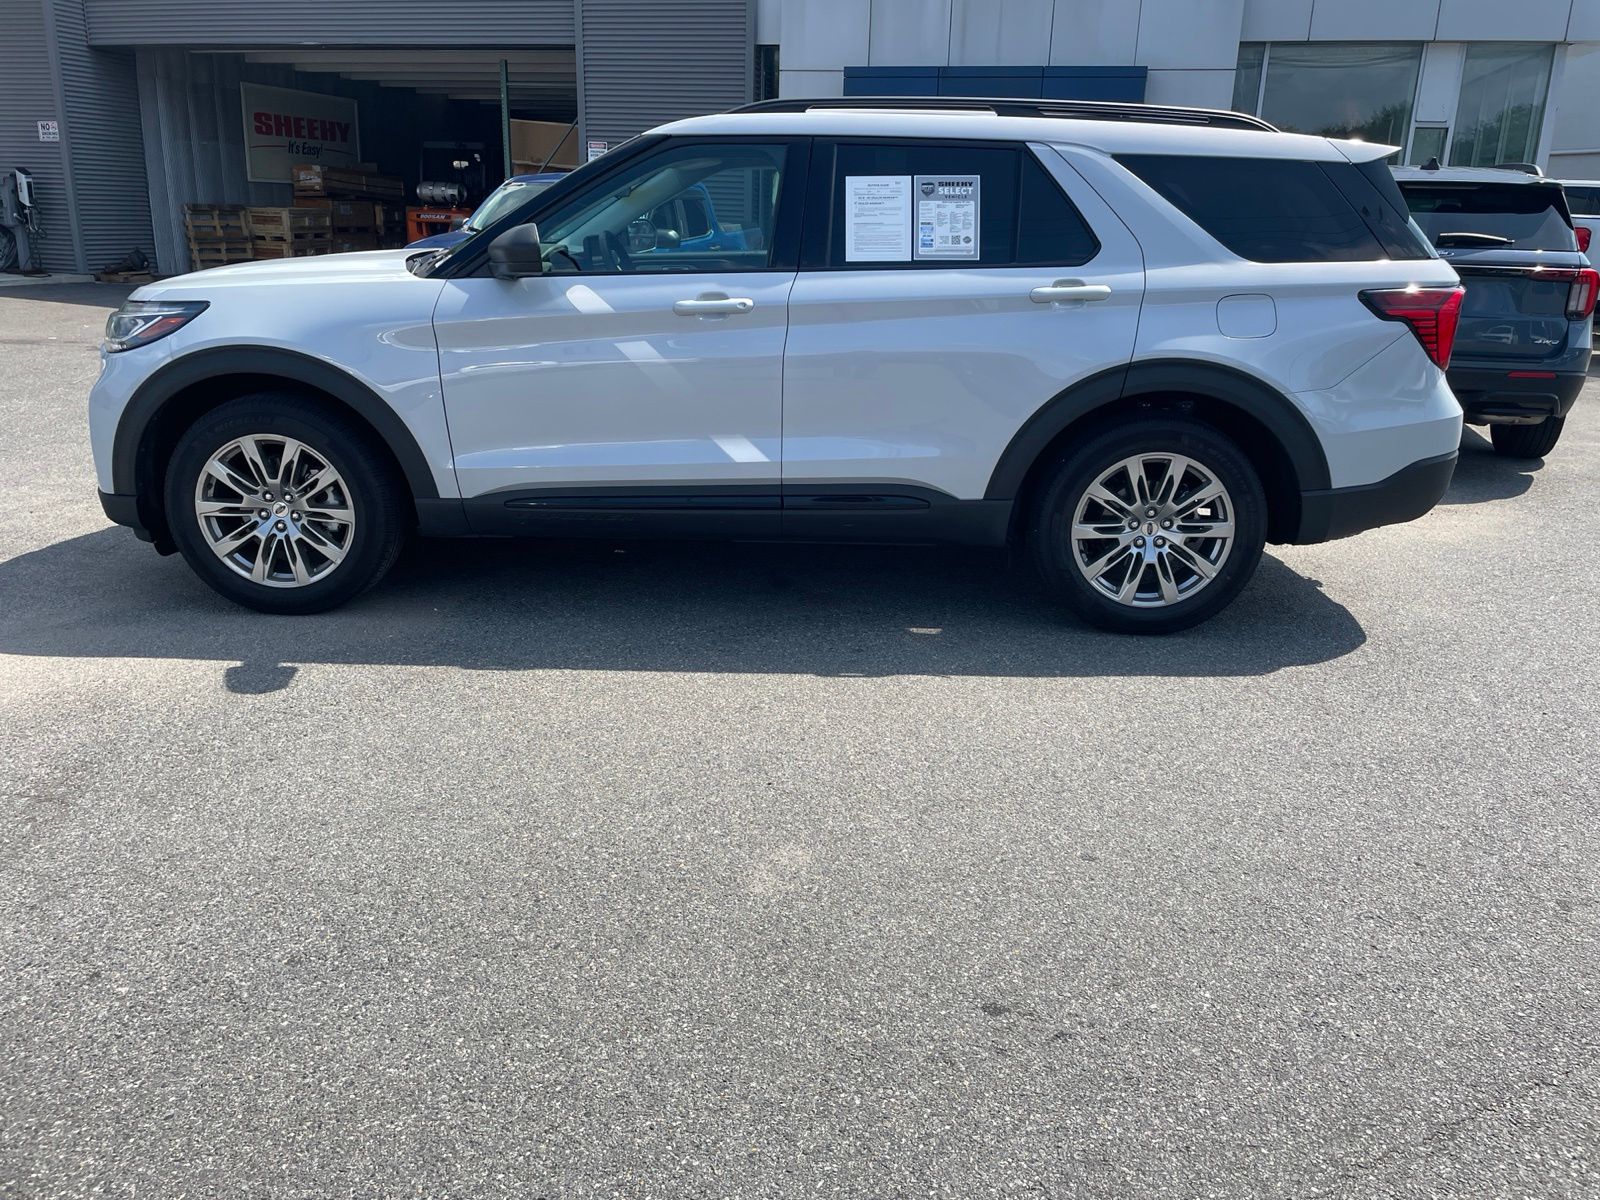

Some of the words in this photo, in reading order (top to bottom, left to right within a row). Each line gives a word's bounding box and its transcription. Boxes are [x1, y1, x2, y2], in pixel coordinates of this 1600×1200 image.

[40, 123, 50, 131] NO
[253, 112, 351, 143] SHEEHY
[288, 140, 300, 154] It's
[302, 142, 323, 158] Easy!
[938, 187, 974, 195] SELECT
